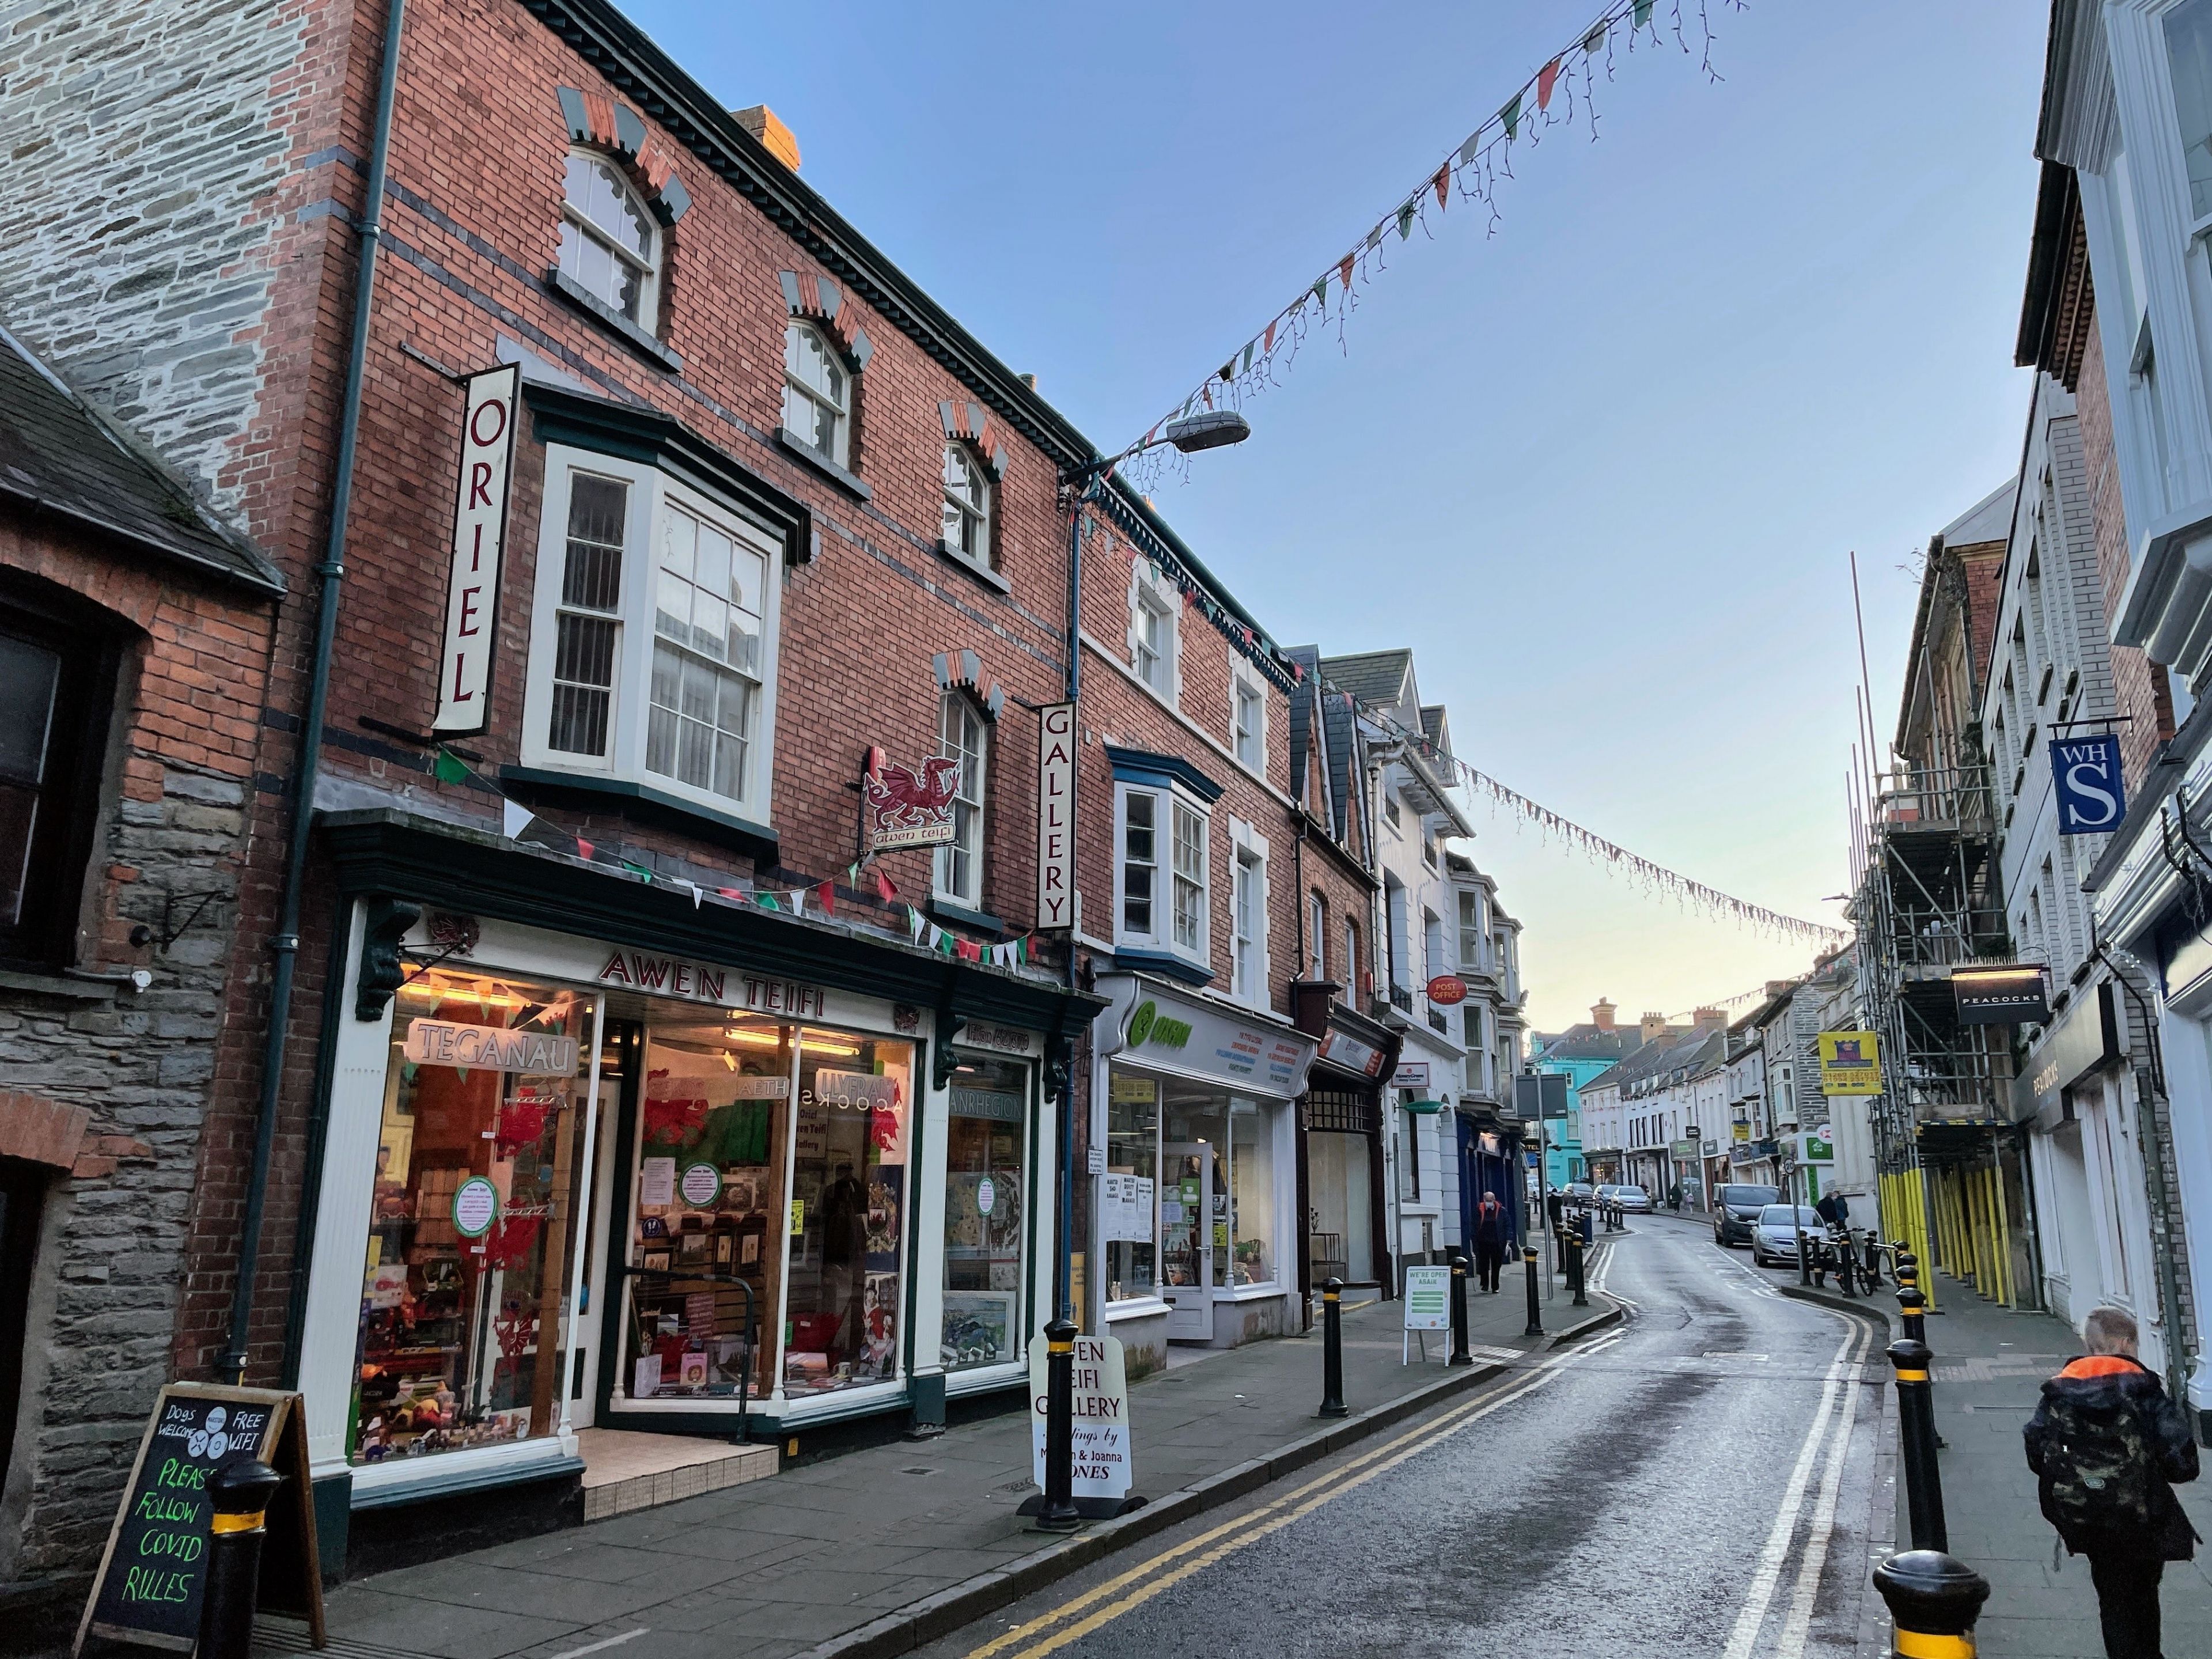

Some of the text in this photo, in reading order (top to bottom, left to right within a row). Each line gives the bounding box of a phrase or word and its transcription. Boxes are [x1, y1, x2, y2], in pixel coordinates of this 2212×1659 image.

[452, 399, 506, 703] ORIEL
[2060, 743, 2109, 764] WH
[2066, 762, 2118, 825] S
[1044, 710, 1070, 922] GALLERY
[876, 827, 951, 843] awen teifi
[599, 951, 825, 1018] AWEN TEIFI
[1433, 991, 1461, 999] OFFICE
[1962, 995, 2040, 1004] PEACOCKS
[417, 1024, 571, 1072] TEGANAU
[949, 1090, 1022, 1119] ANRHEGION
[166, 1404, 265, 1430] Dogs FREE
[158, 1423, 260, 1451] WELCOME WIFI
[1104, 1427, 1118, 1447] by
[1079, 1449, 1088, 1460] &
[1091, 1450, 1123, 1463] Joanna
[157, 1457, 218, 1491] PLEAS
[135, 1491, 201, 1524] FOLLOW
[139, 1529, 202, 1563] COVID
[122, 1566, 195, 1603] RULES
